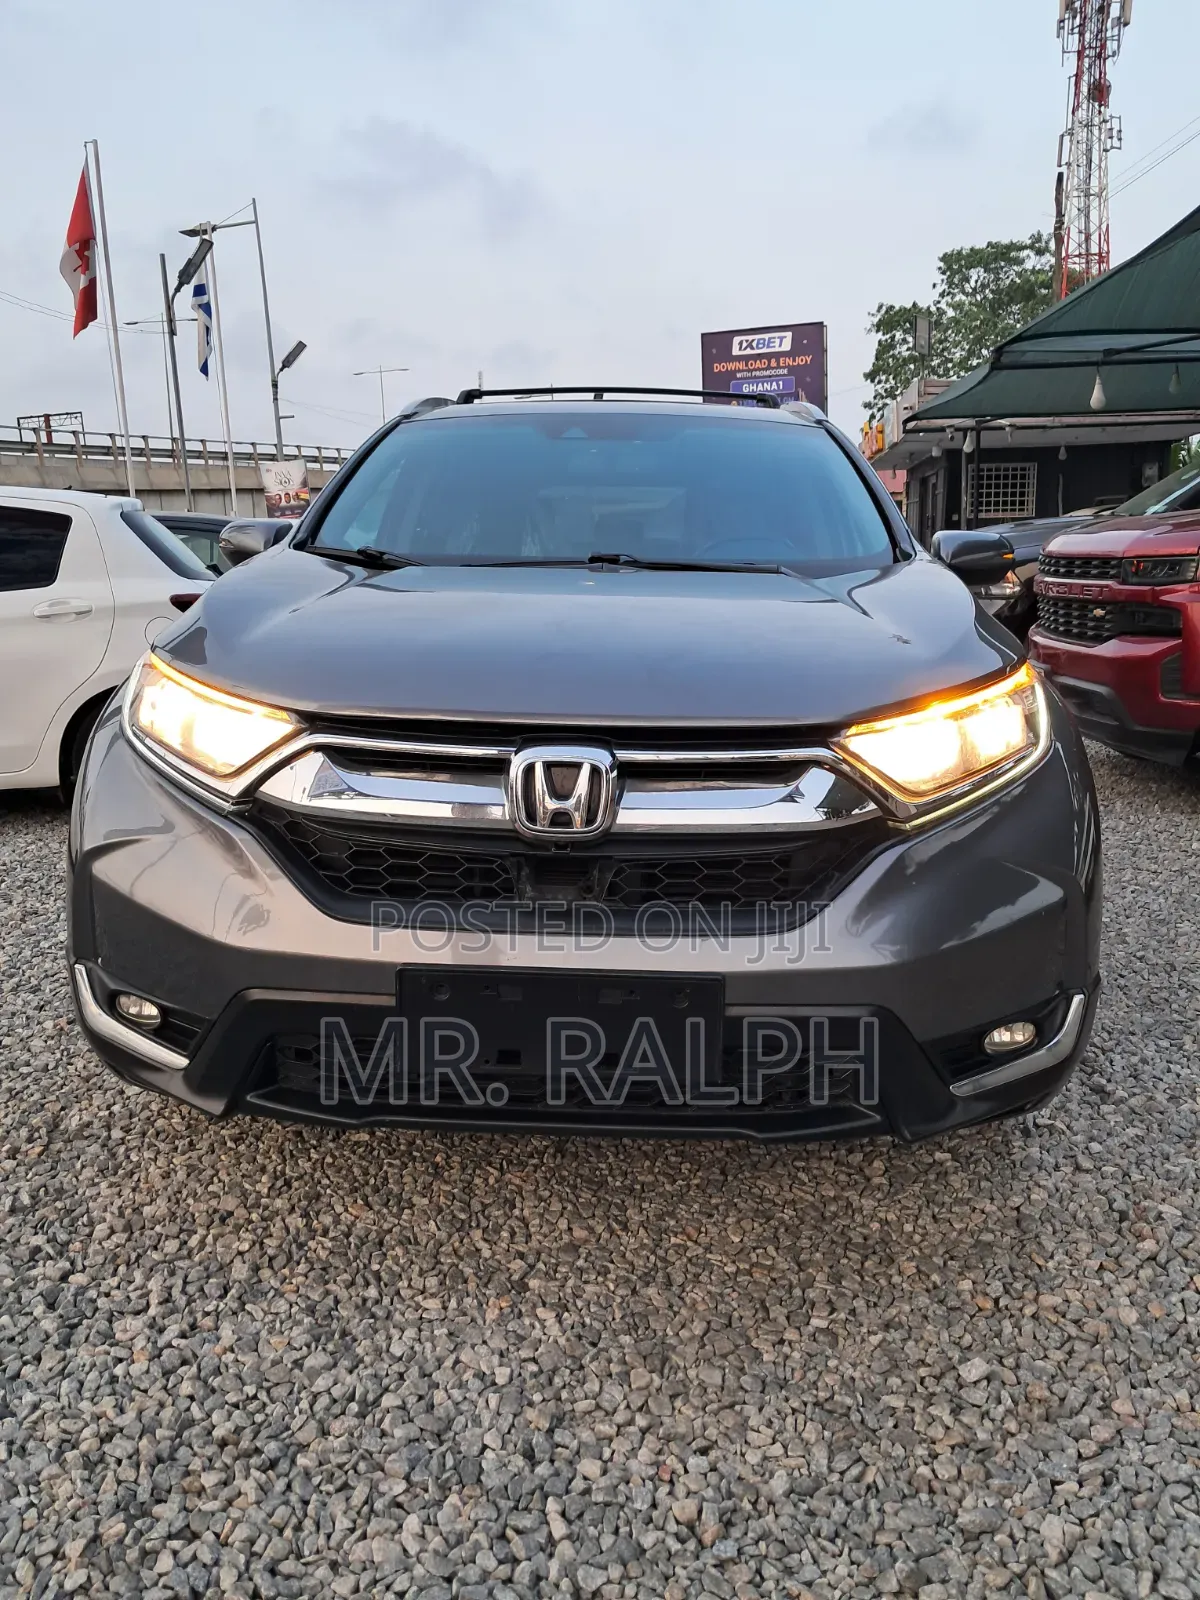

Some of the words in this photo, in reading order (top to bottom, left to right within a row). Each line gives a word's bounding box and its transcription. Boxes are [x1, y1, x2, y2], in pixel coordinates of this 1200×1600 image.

[737, 335, 788, 351] 1XBET
[714, 358, 768, 372] DOWNLOAD
[770, 358, 777, 367] &
[780, 355, 812, 366] ENJOY
[736, 370, 751, 378] WITH
[752, 368, 788, 377] PROMOCODE
[742, 380, 784, 393] GHANA1
